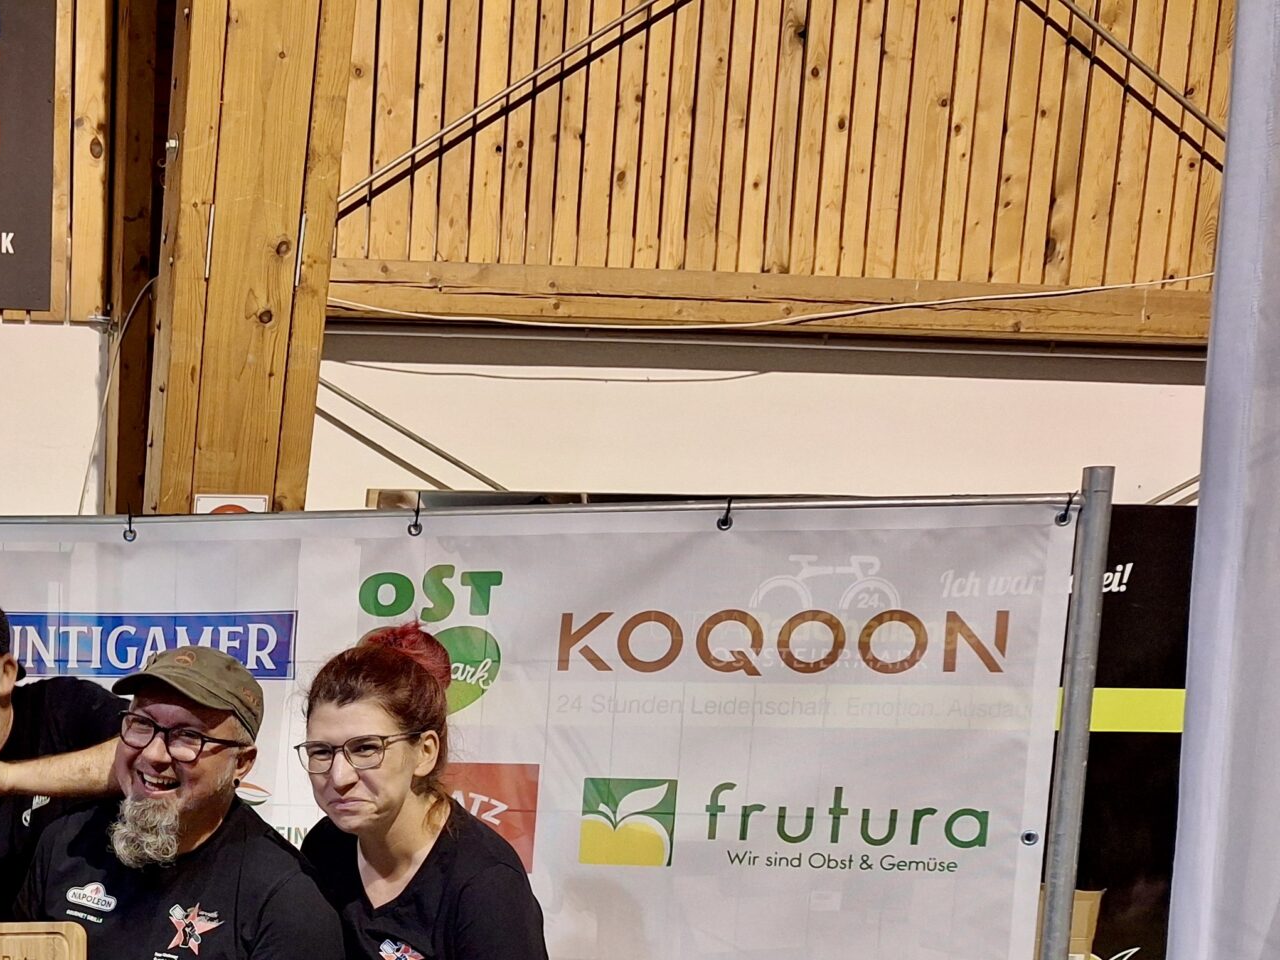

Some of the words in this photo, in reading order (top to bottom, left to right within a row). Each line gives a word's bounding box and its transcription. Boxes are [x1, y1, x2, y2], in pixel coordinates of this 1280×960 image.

[358, 563, 504, 622] OST
[556, 608, 1010, 677] KOQOON
[705, 781, 990, 849] frutura
[727, 850, 760, 867] Wir
[765, 852, 802, 868] sind
[808, 853, 854, 870] Obst
[859, 855, 874, 870] &
[880, 854, 959, 873] Gemüse
[71, 891, 113, 909] NAPOLEON
